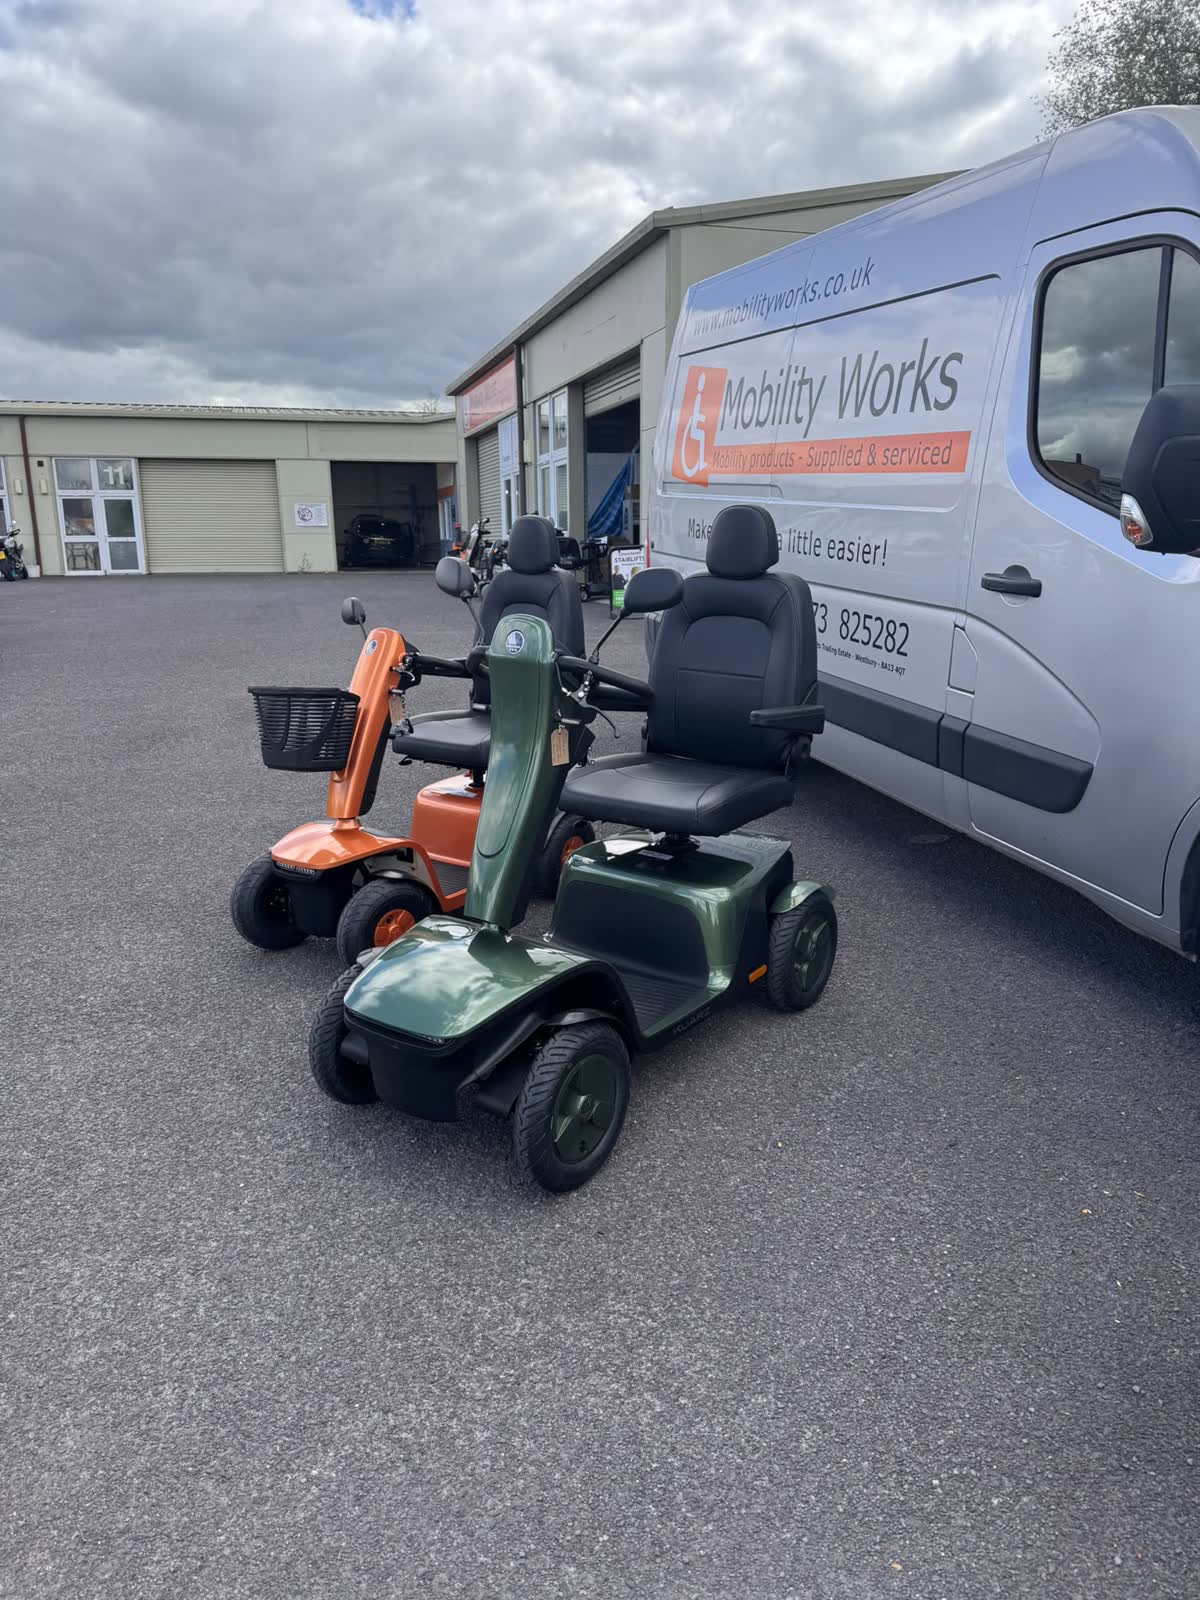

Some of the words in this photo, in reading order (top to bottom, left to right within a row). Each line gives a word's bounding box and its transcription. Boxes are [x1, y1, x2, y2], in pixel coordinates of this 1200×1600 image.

[693, 257, 875, 336] www.mobilityworks.co.uk
[720, 364, 827, 439] Mobility
[838, 337, 963, 420] Works
[103, 465, 125, 486] 11
[711, 449, 749, 470] Mobility
[749, 448, 795, 471] products
[806, 444, 863, 471] Supplied
[866, 443, 878, 466] &
[882, 440, 953, 466] serviced
[787, 527, 822, 557] little
[827, 536, 888, 567] easier!
[839, 608, 909, 657] 825282
[881, 661, 894, 672] BA13
